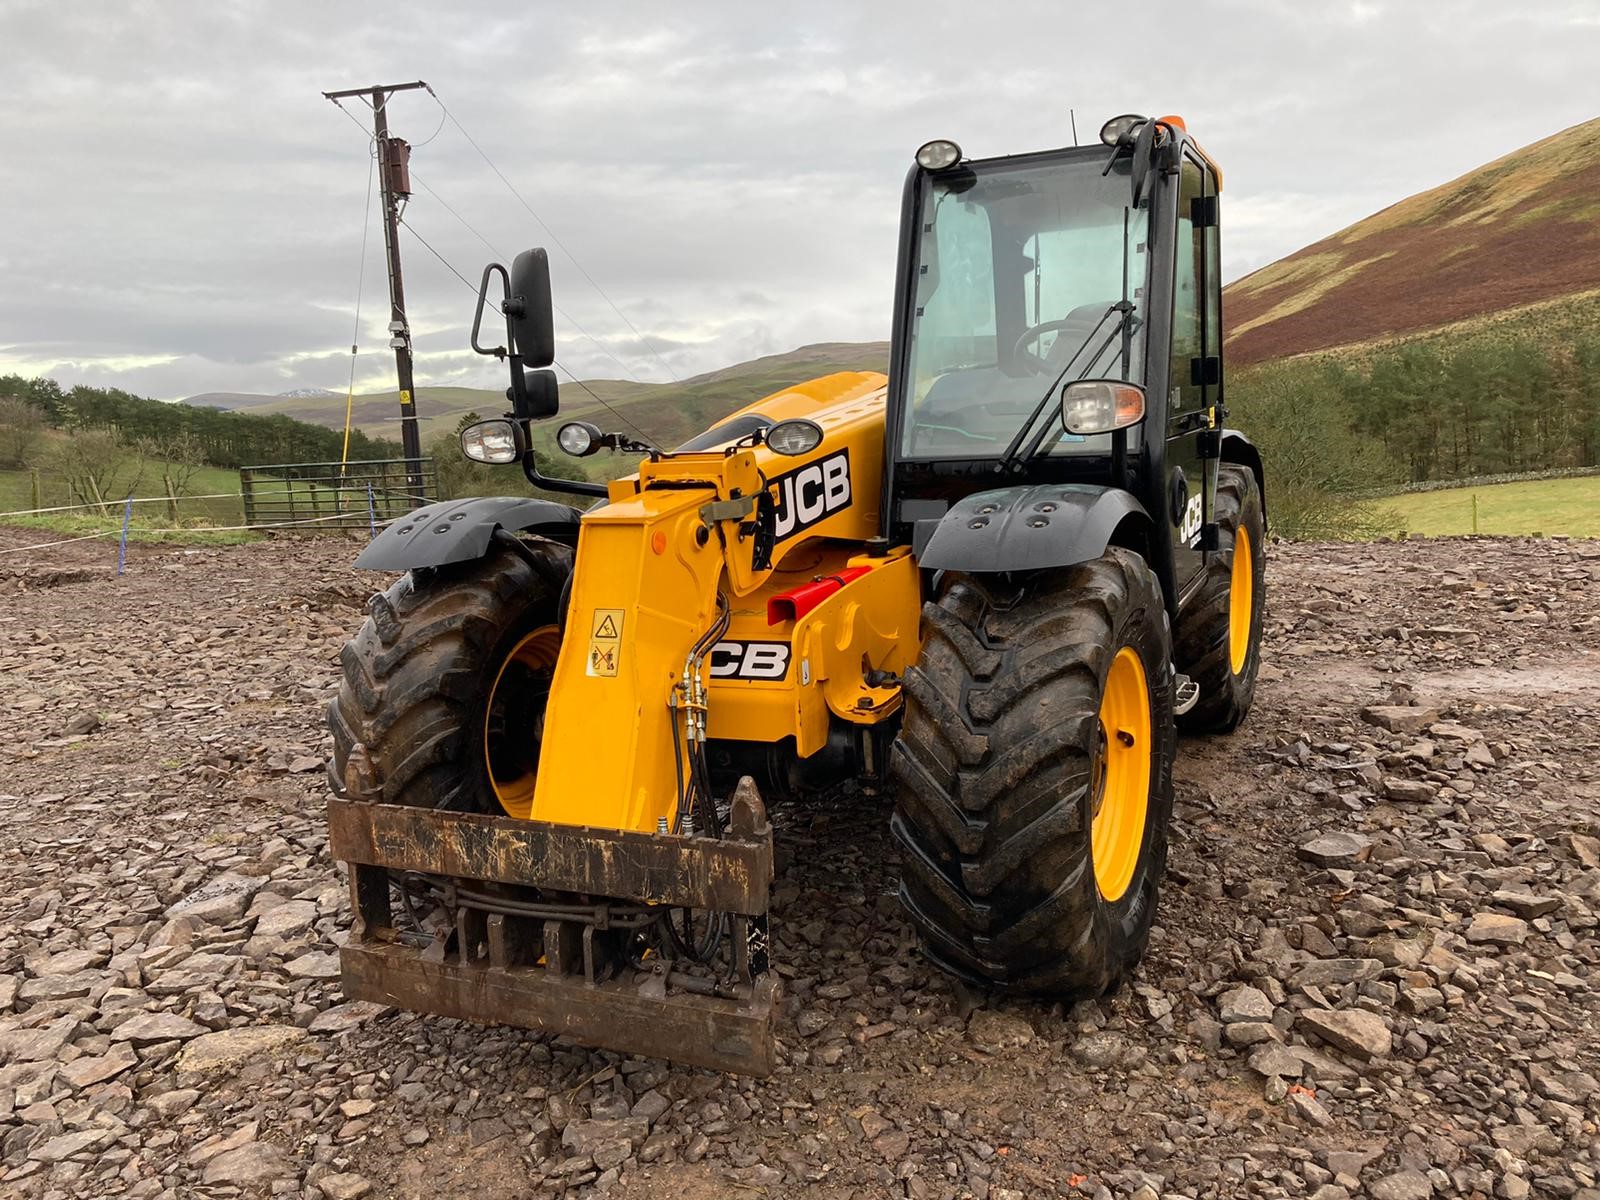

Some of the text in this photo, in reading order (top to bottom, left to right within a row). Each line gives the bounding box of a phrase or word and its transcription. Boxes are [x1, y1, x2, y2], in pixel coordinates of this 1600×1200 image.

[775, 454, 850, 537] JCB
[1180, 493, 1202, 544] JCB
[710, 642, 789, 677] CB
